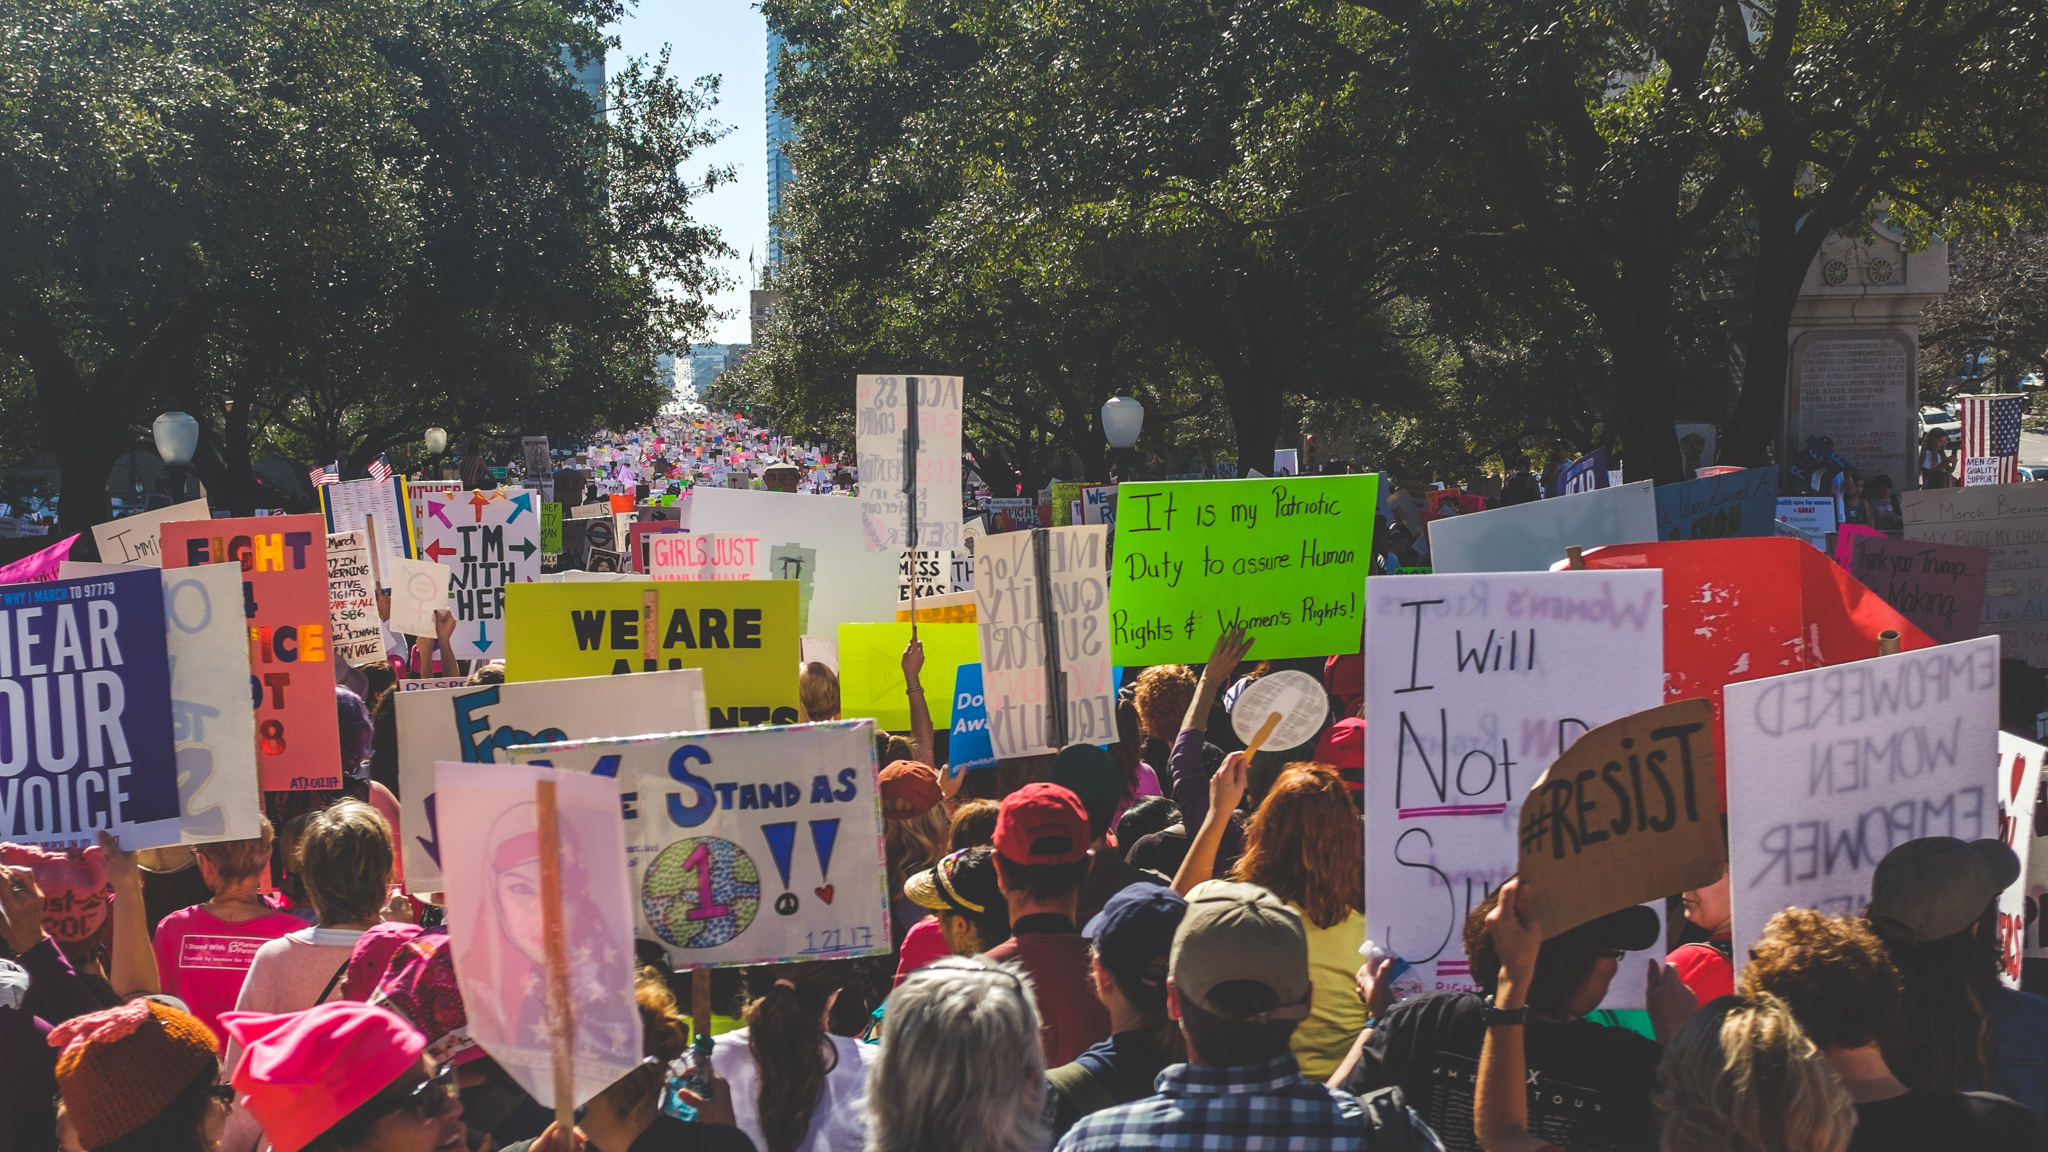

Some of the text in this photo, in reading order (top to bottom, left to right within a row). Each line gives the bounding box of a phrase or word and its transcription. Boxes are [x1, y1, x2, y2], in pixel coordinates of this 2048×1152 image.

[1966, 457, 1998, 466] MEN OF
[1966, 466, 1998, 475] QUALITY
[1966, 475, 1998, 483] SUPPORT
[1128, 492, 1177, 532] It
[1231, 503, 1257, 530] my
[1271, 485, 1342, 519] Patriotic
[1797, 506, 1816, 514] GREAT
[1939, 502, 1985, 519] March
[186, 531, 313, 572] FIGHT
[456, 523, 504, 563] I'M
[654, 537, 760, 567] GIRLS JUST
[1923, 529, 2048, 547] MY BODY MY CHOIC
[341, 555, 357, 567] IN
[898, 560, 941, 577] MESS
[1125, 538, 1355, 588] Duty to assure Human
[1855, 539, 1889, 571] Thank
[1889, 555, 1914, 580] you
[449, 561, 516, 592] WITH
[4, 592, 25, 606] WHY
[35, 588, 67, 603] MARCH
[69, 585, 82, 599] TO
[84, 582, 115, 598] 97779
[359, 597, 374, 607] ALL
[456, 587, 506, 622] HER
[897, 584, 946, 602] EXAS
[1888, 581, 1959, 631] Making
[571, 608, 762, 651] WE ARE
[1112, 609, 1174, 650] Rights
[1217, 606, 1292, 636] Women's
[1301, 592, 1356, 627] Rights!
[1394, 598, 1536, 695] I Will
[1396, 707, 1519, 810] Not
[809, 767, 858, 804] AS
[188, 943, 208, 951] Stand
